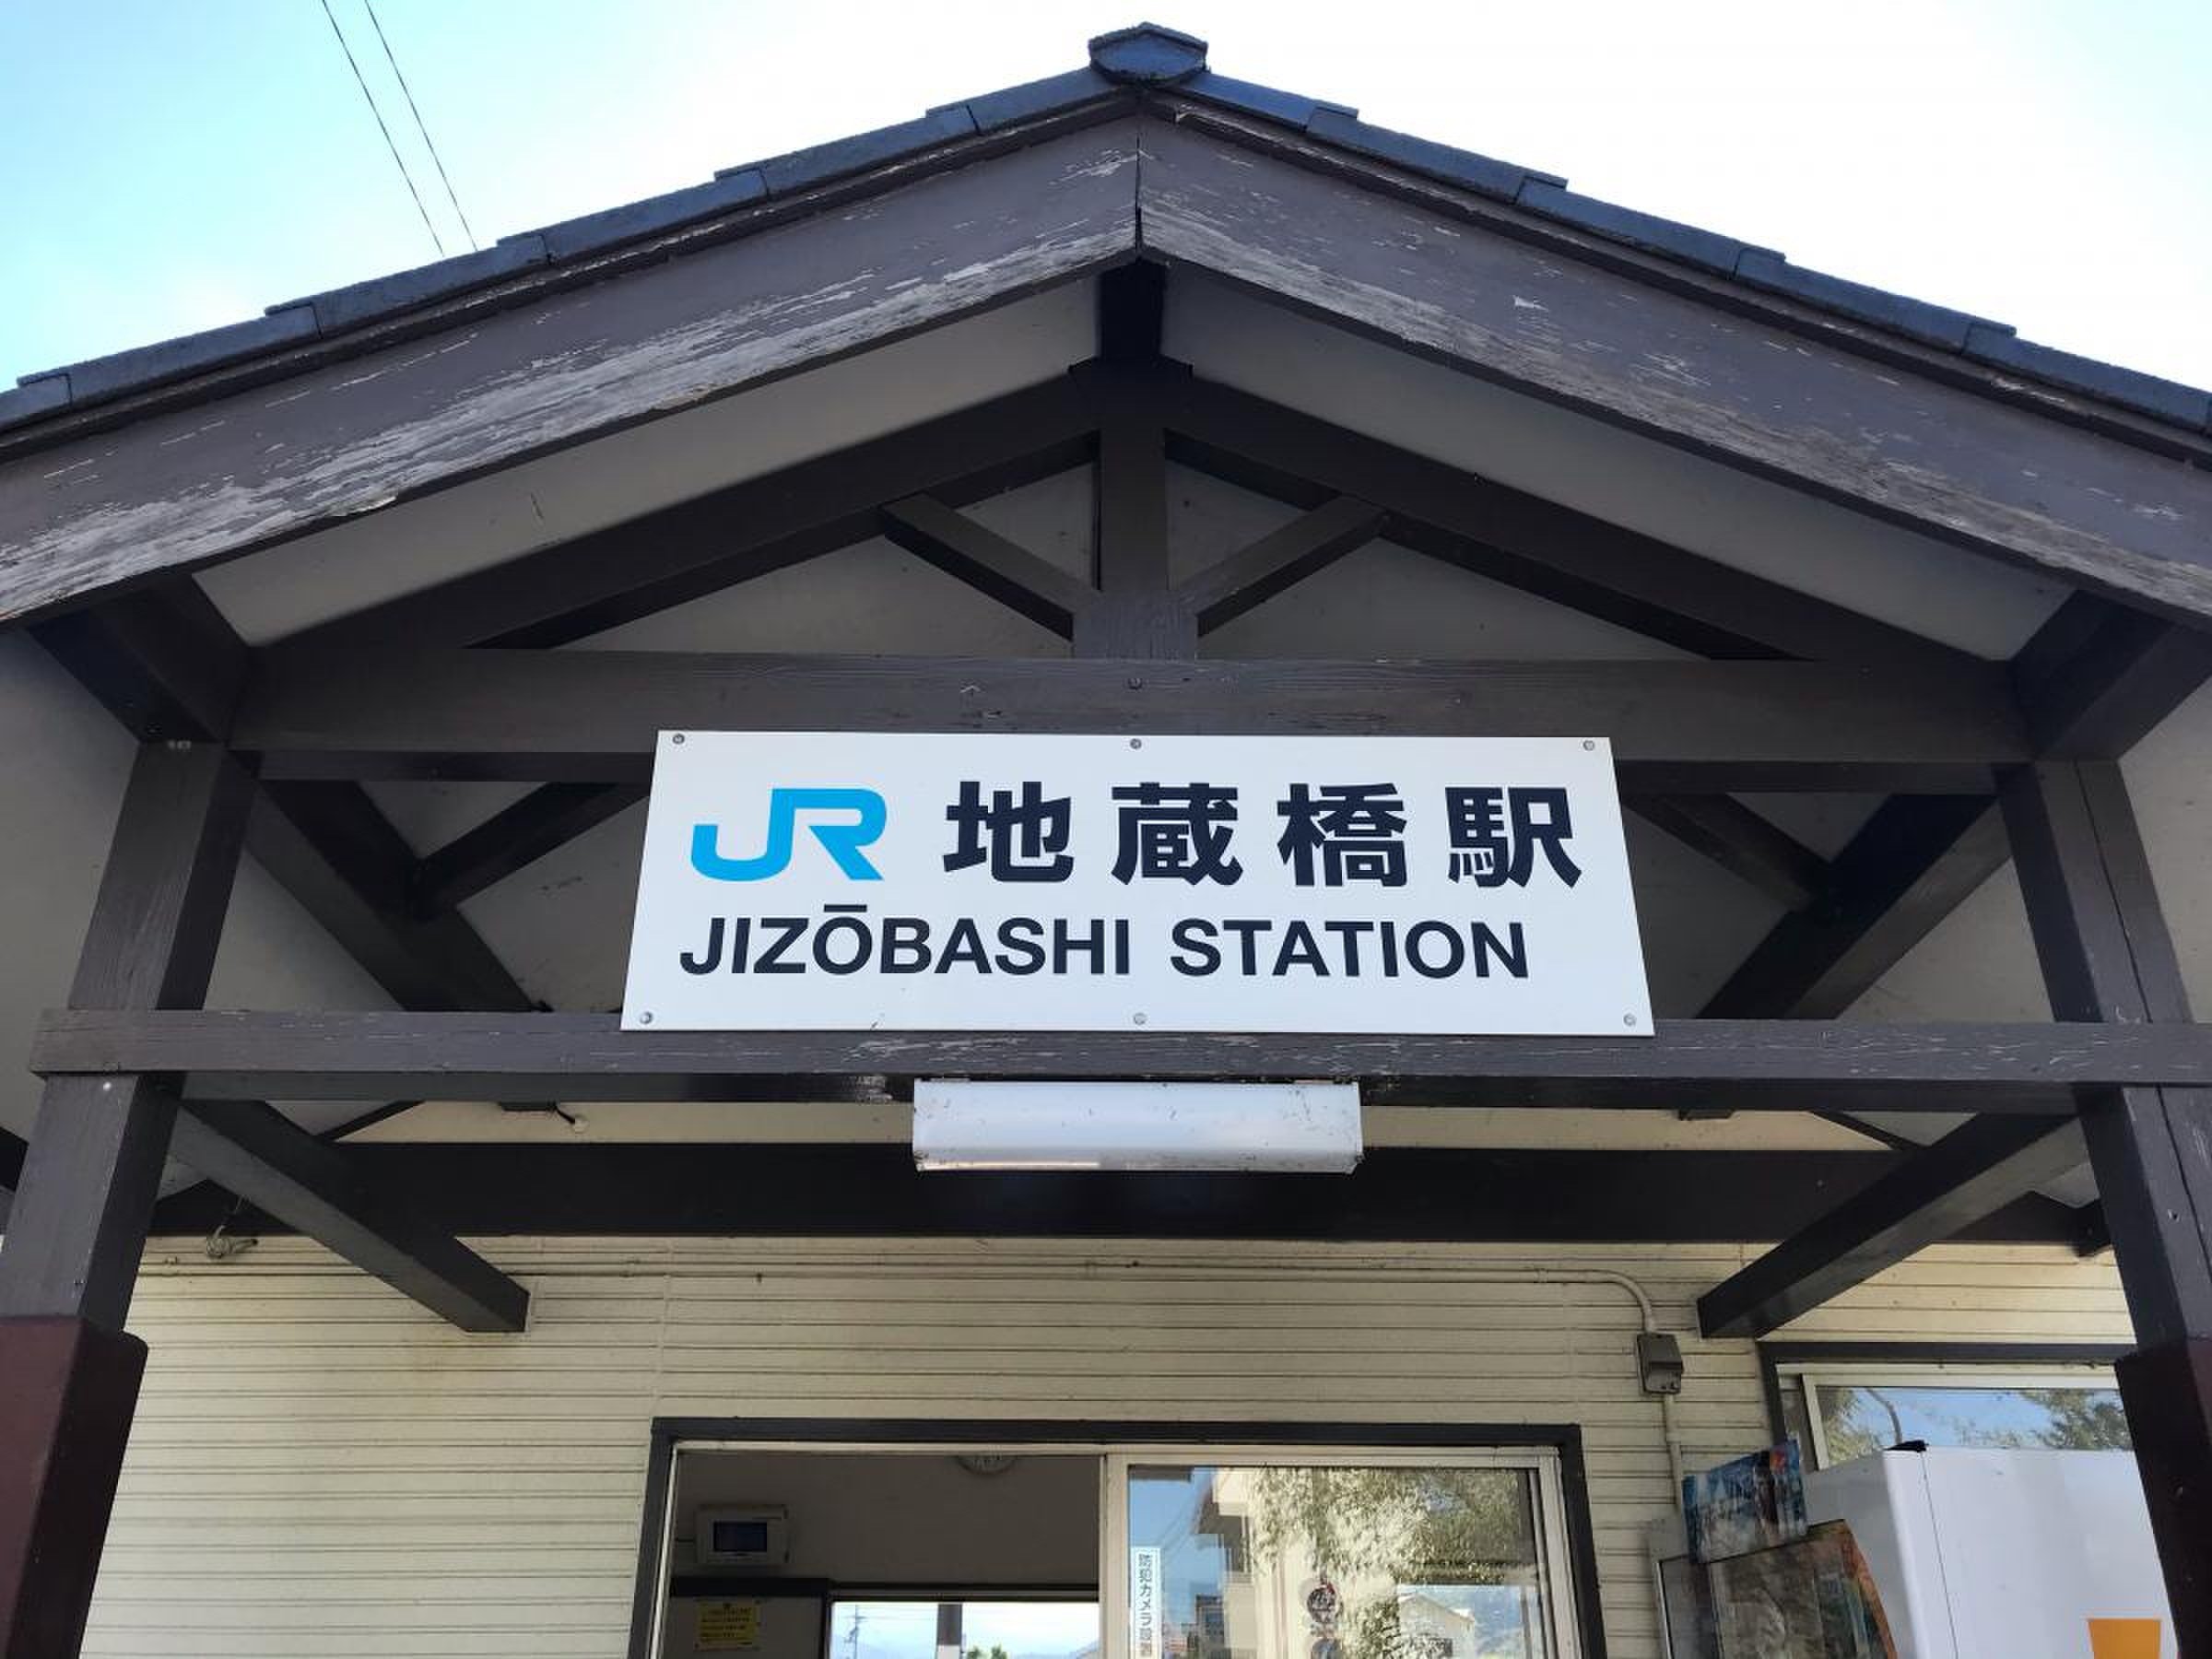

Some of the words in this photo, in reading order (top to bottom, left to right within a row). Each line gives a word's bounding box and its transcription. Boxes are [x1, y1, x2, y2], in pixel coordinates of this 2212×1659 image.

[688, 787, 887, 882] JR
[942, 781, 1583, 888] 地蔵橋駅
[679, 903, 1130, 976] JIZŌBASHI
[1169, 918, 1529, 979] STATION
